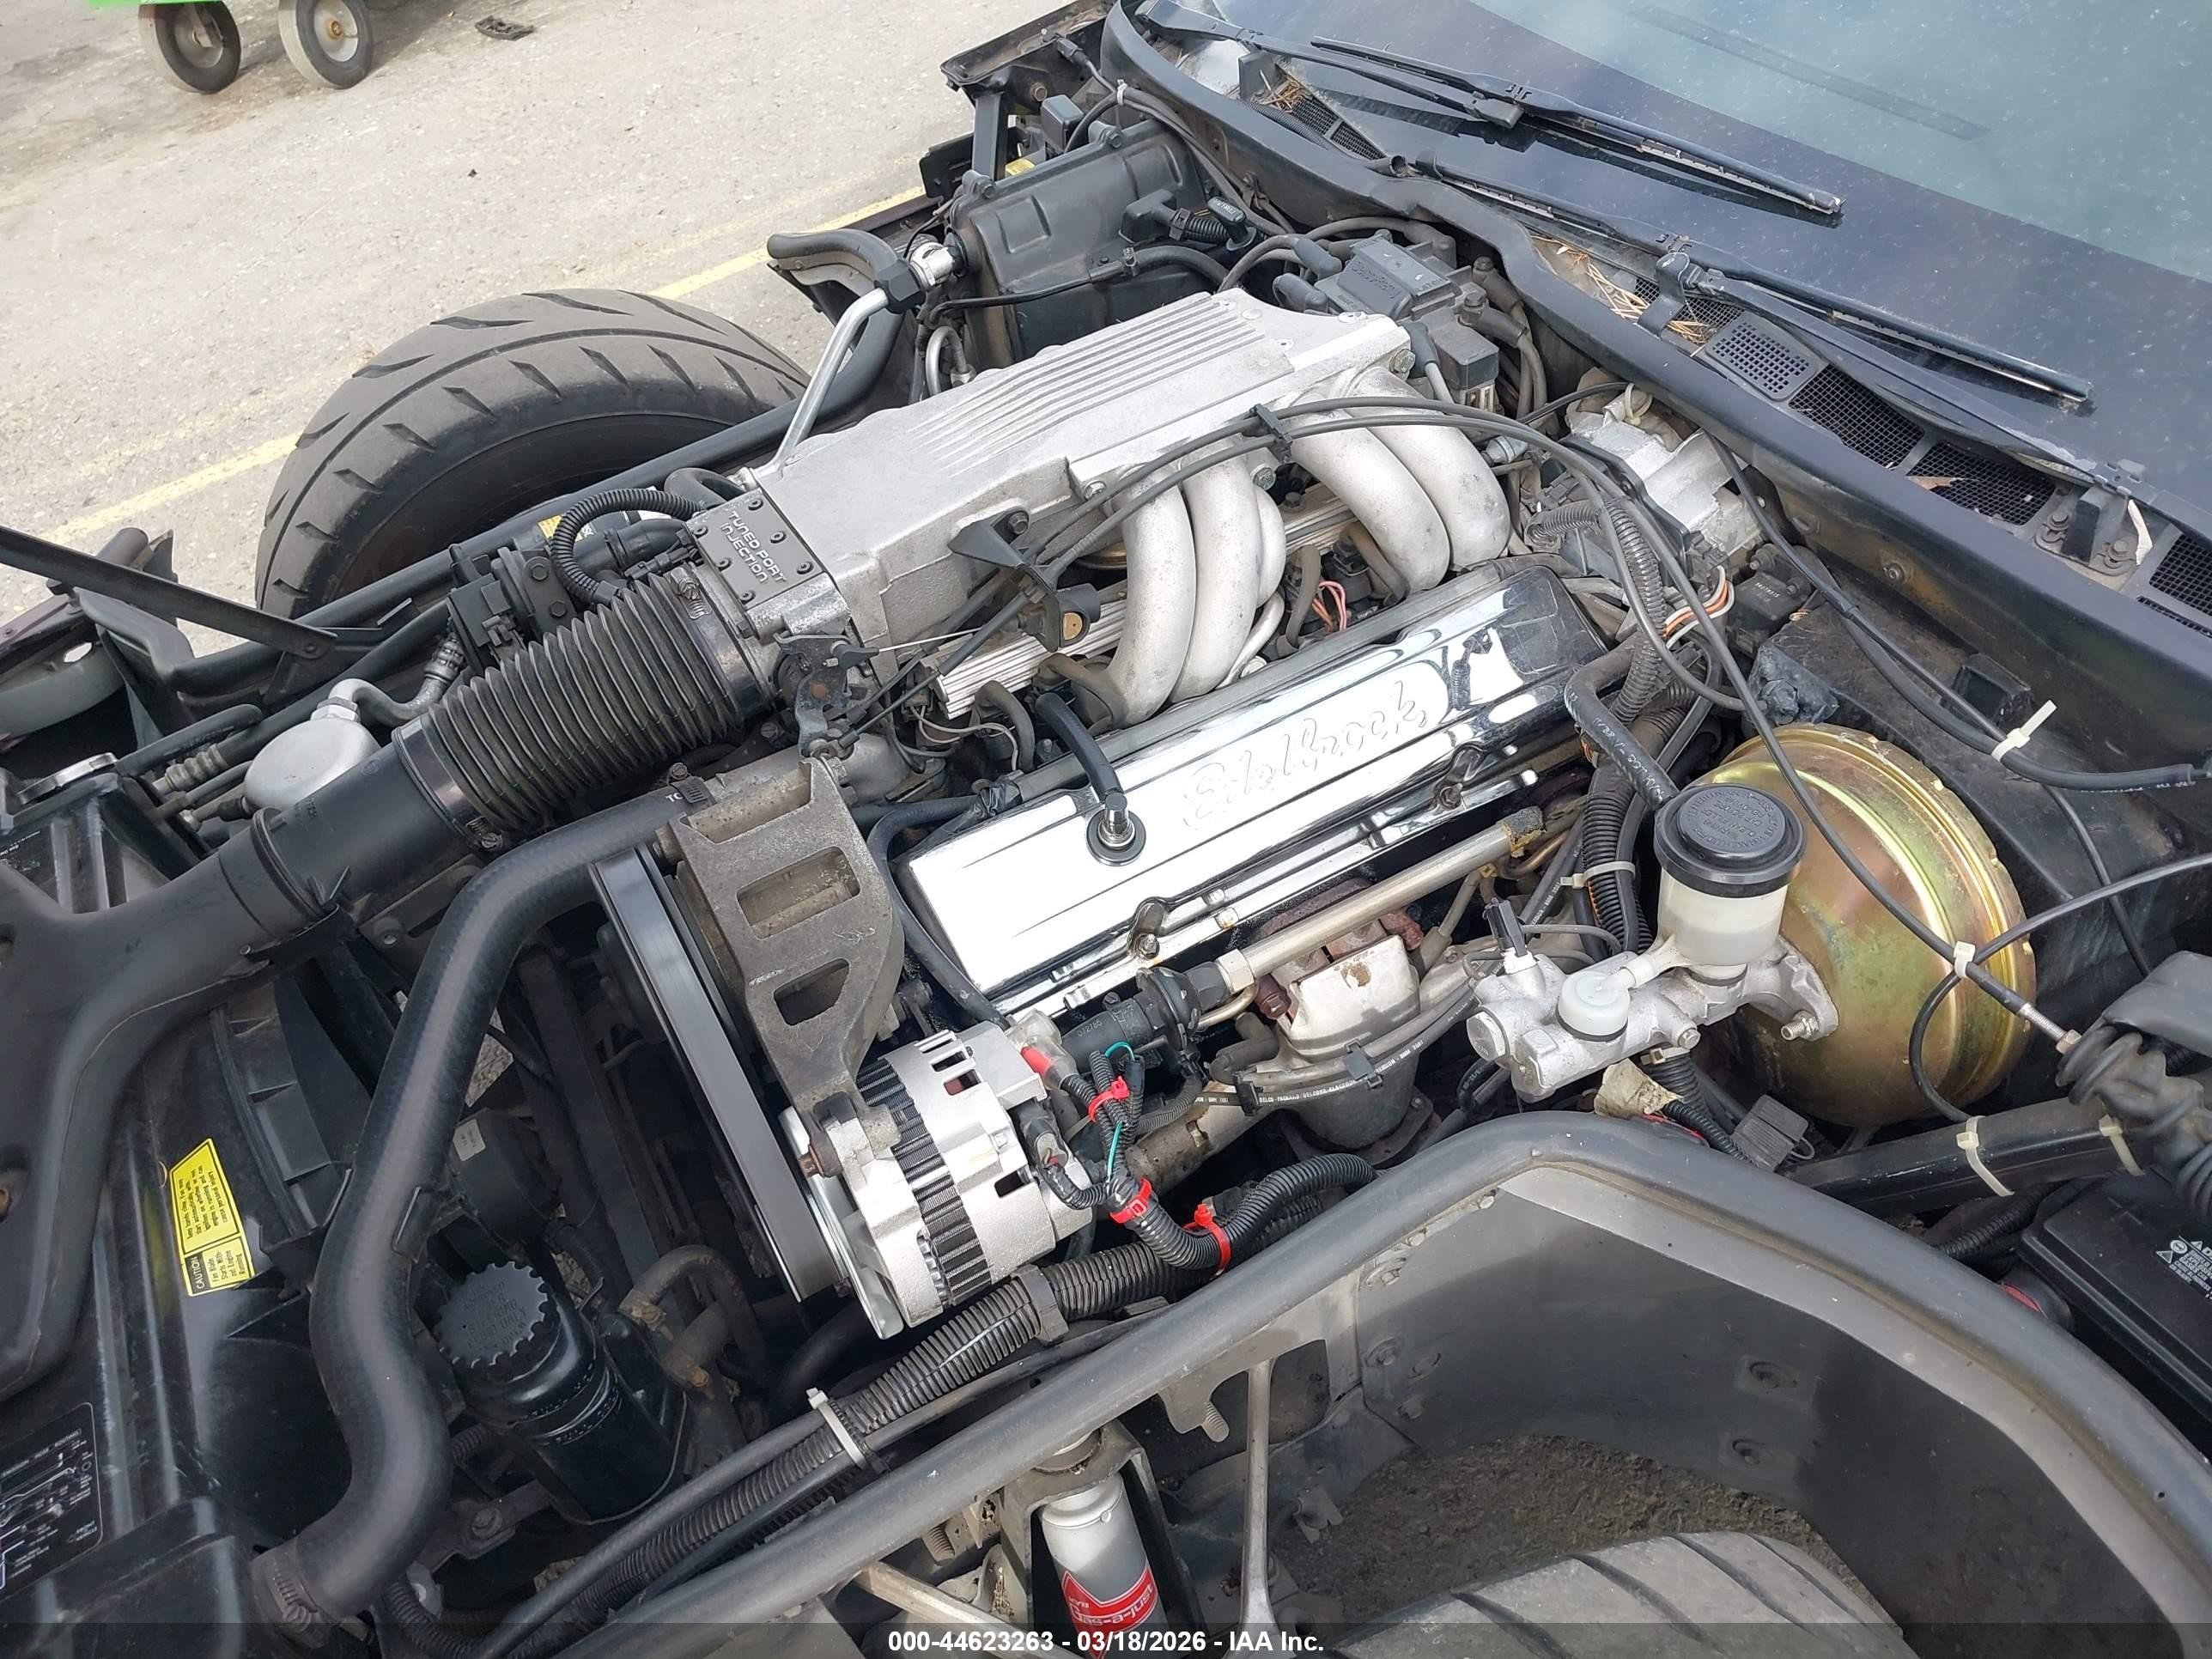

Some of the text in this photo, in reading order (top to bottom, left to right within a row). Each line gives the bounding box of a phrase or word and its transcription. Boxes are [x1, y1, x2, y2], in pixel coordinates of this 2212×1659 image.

[721, 525, 769, 583] INJECTION
[728, 511, 787, 582] TUNED PORT
[1183, 680, 1427, 830] Edelbrock
[191, 1255, 205, 1289] CAUTION
